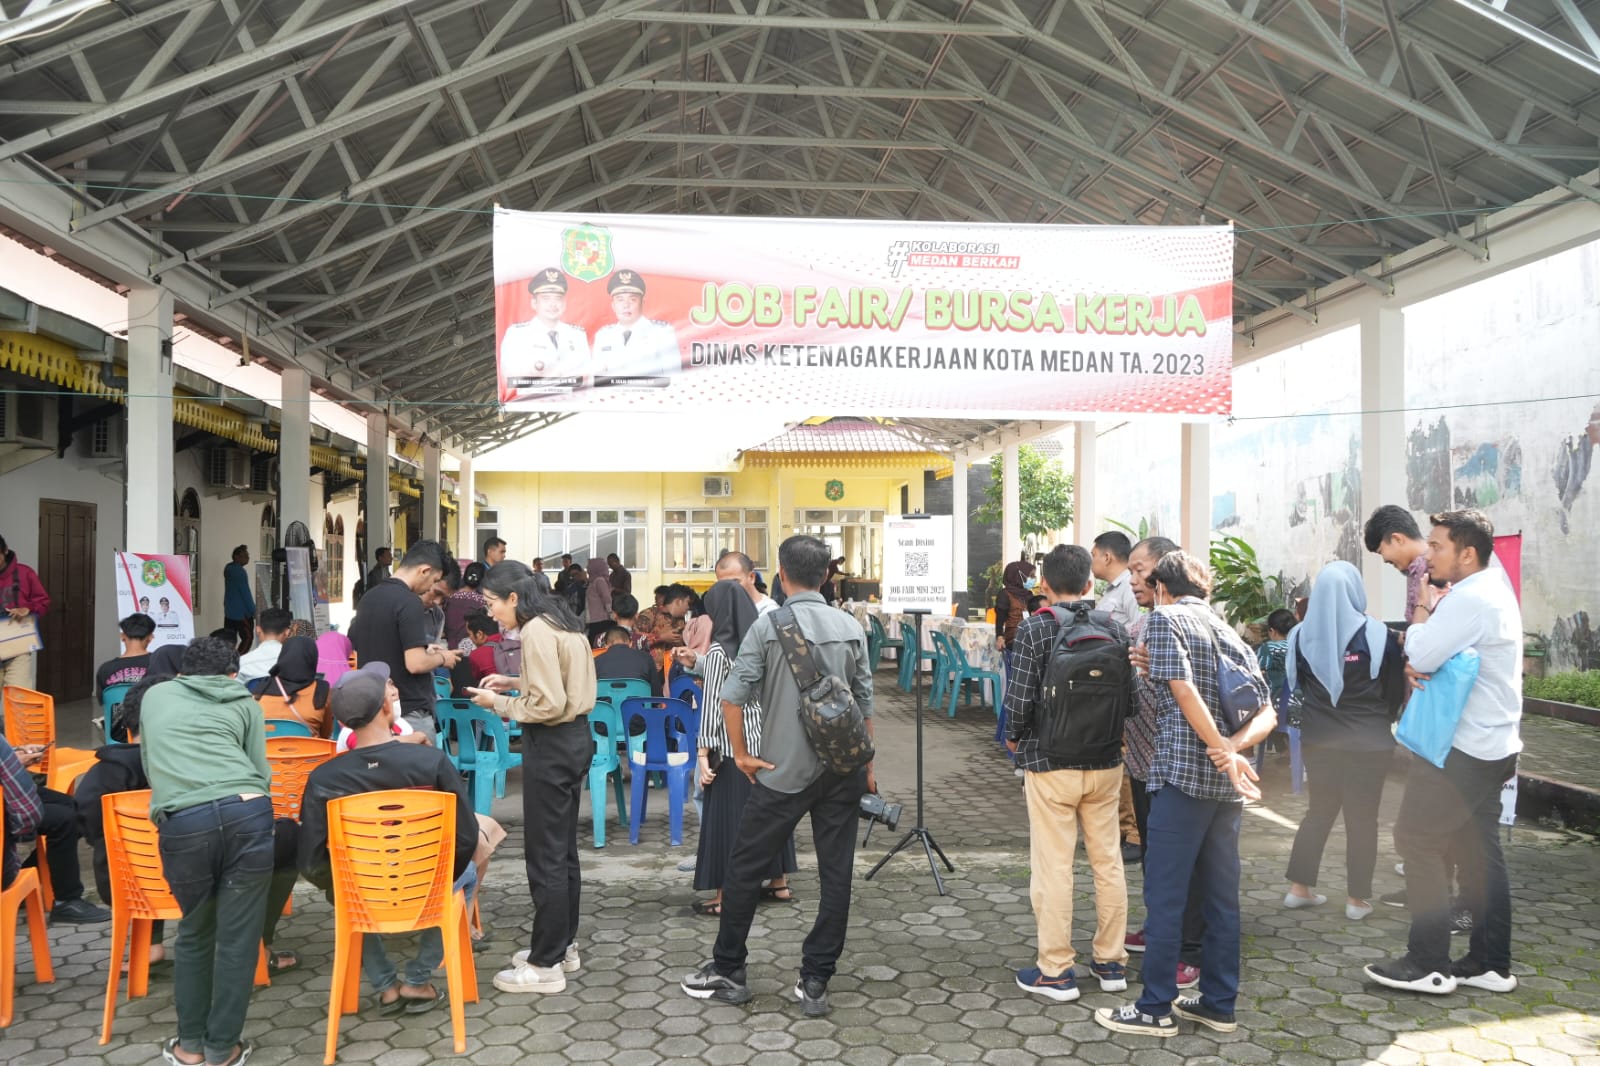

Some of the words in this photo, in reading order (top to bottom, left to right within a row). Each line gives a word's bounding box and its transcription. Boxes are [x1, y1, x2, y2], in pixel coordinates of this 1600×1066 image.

[911, 241, 999, 254] KOLABORASI
[910, 256, 958, 266] MEDAN
[962, 257, 1018, 268] BERKAH
[691, 283, 782, 328] JOB
[793, 286, 913, 331] FAIR/
[924, 288, 1065, 334] BURSA
[1075, 293, 1207, 337] KERJA
[691, 342, 757, 366] DINAS
[763, 345, 978, 371] KETENAGAKERJAAN
[983, 348, 1034, 372] KOTA
[1041, 350, 1113, 373] MEDAN
[898, 538, 914, 547] Scan
[890, 585, 900, 595] JOB
[902, 585, 915, 594] FAIR
